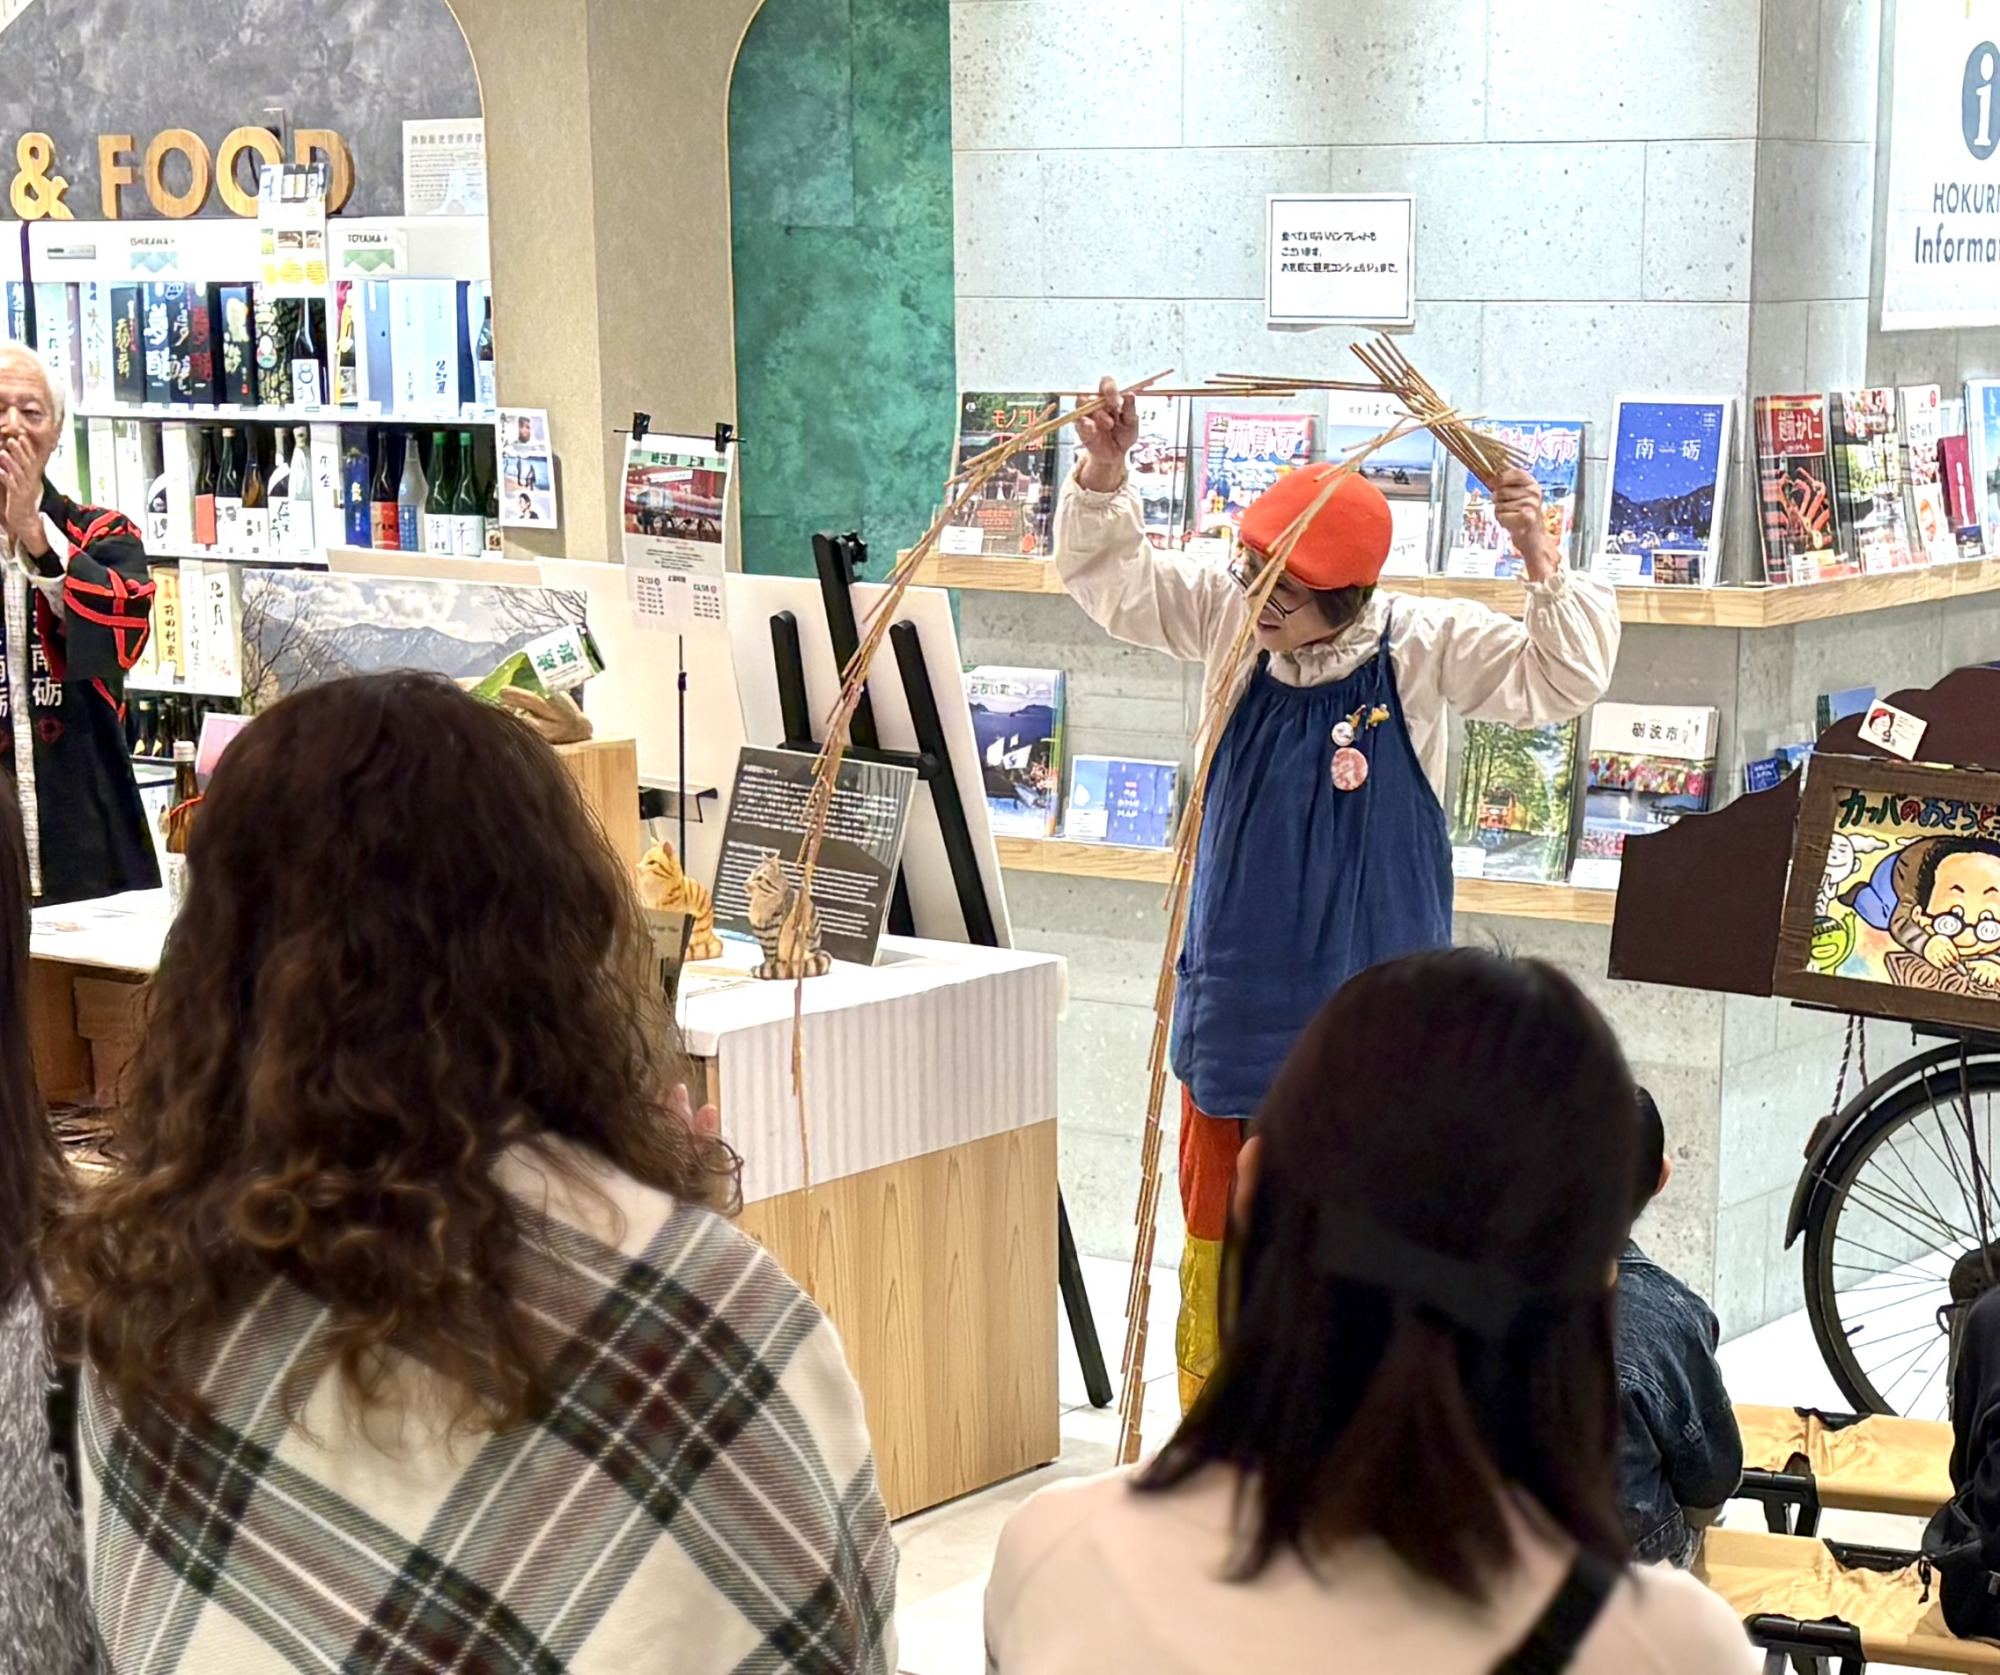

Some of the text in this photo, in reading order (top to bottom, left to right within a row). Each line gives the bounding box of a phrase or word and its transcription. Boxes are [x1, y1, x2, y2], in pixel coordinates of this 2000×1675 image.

[10, 132, 74, 219] &
[98, 126, 356, 219] FOOD
[1915, 222, 2000, 264] Informa
[1838, 788, 2000, 832] カッパのおさらと
